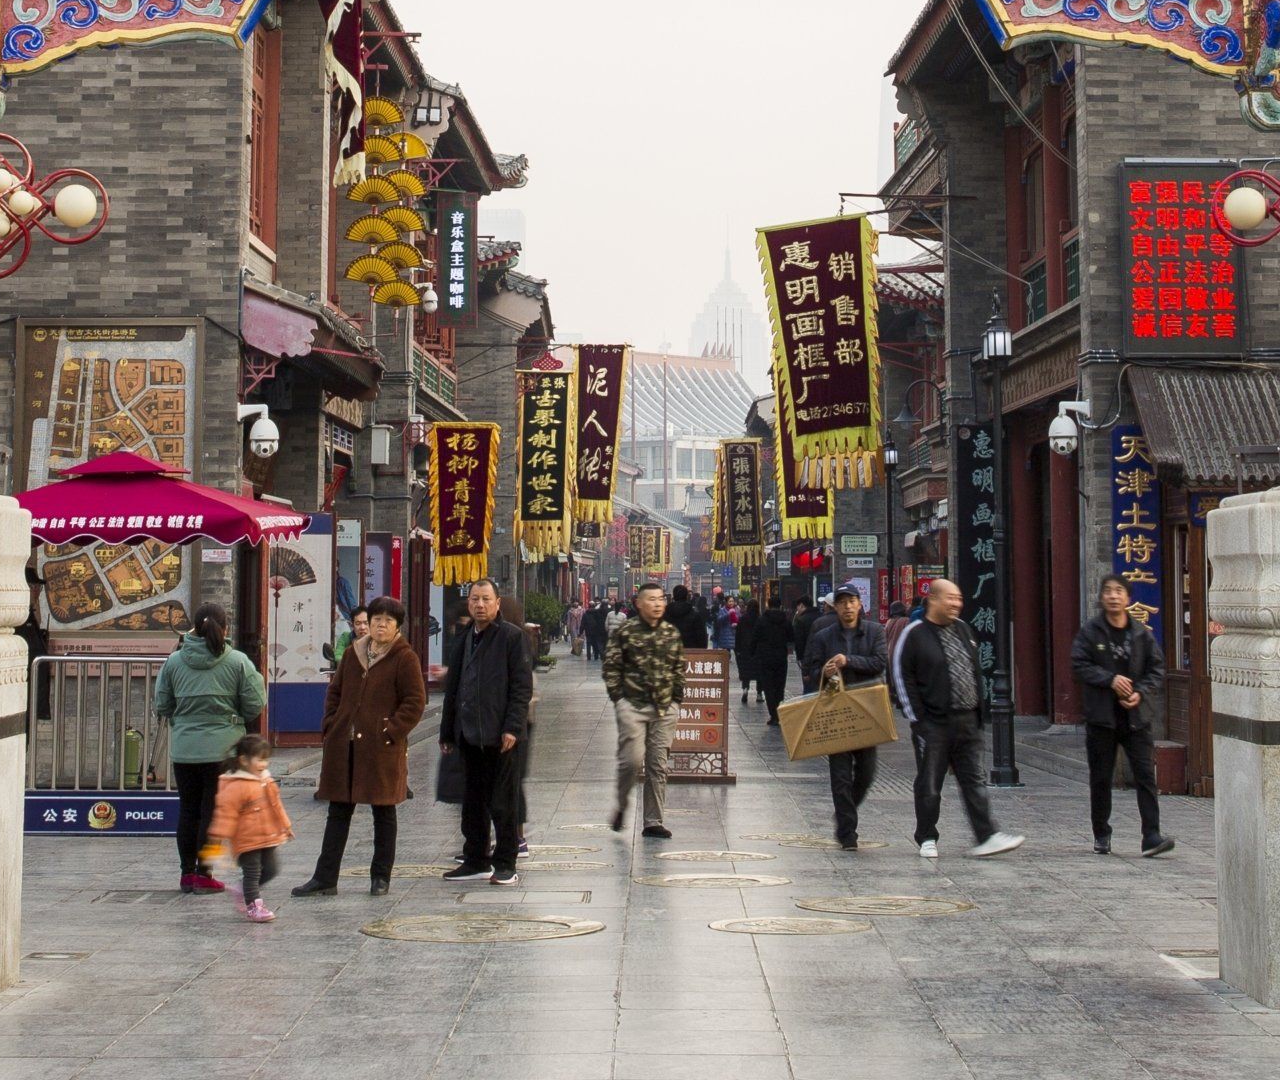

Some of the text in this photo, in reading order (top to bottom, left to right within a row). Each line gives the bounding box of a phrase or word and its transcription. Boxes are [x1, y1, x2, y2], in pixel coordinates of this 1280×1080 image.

[1132, 233, 1233, 257] 自由平等
[449, 211, 465, 309] 音乐盒主题咖啡
[1131, 260, 1235, 284] 公正法治
[827, 251, 864, 367] 销售部
[1132, 287, 1236, 310] 爱国敬业
[779, 241, 830, 404] 惠明画框厂
[1132, 313, 1236, 338] 诚信友善
[527, 390, 561, 515] 古琴制作世家
[49, 518, 66, 528] 自由
[70, 517, 86, 528] 平等
[89, 517, 106, 528] 公正
[107, 517, 125, 528] 法治
[685, 661, 722, 675] 人流密集
[673, 730, 700, 741] 电动车通行
[42, 808, 78, 823] 公安
[125, 811, 164, 820] POLICE
